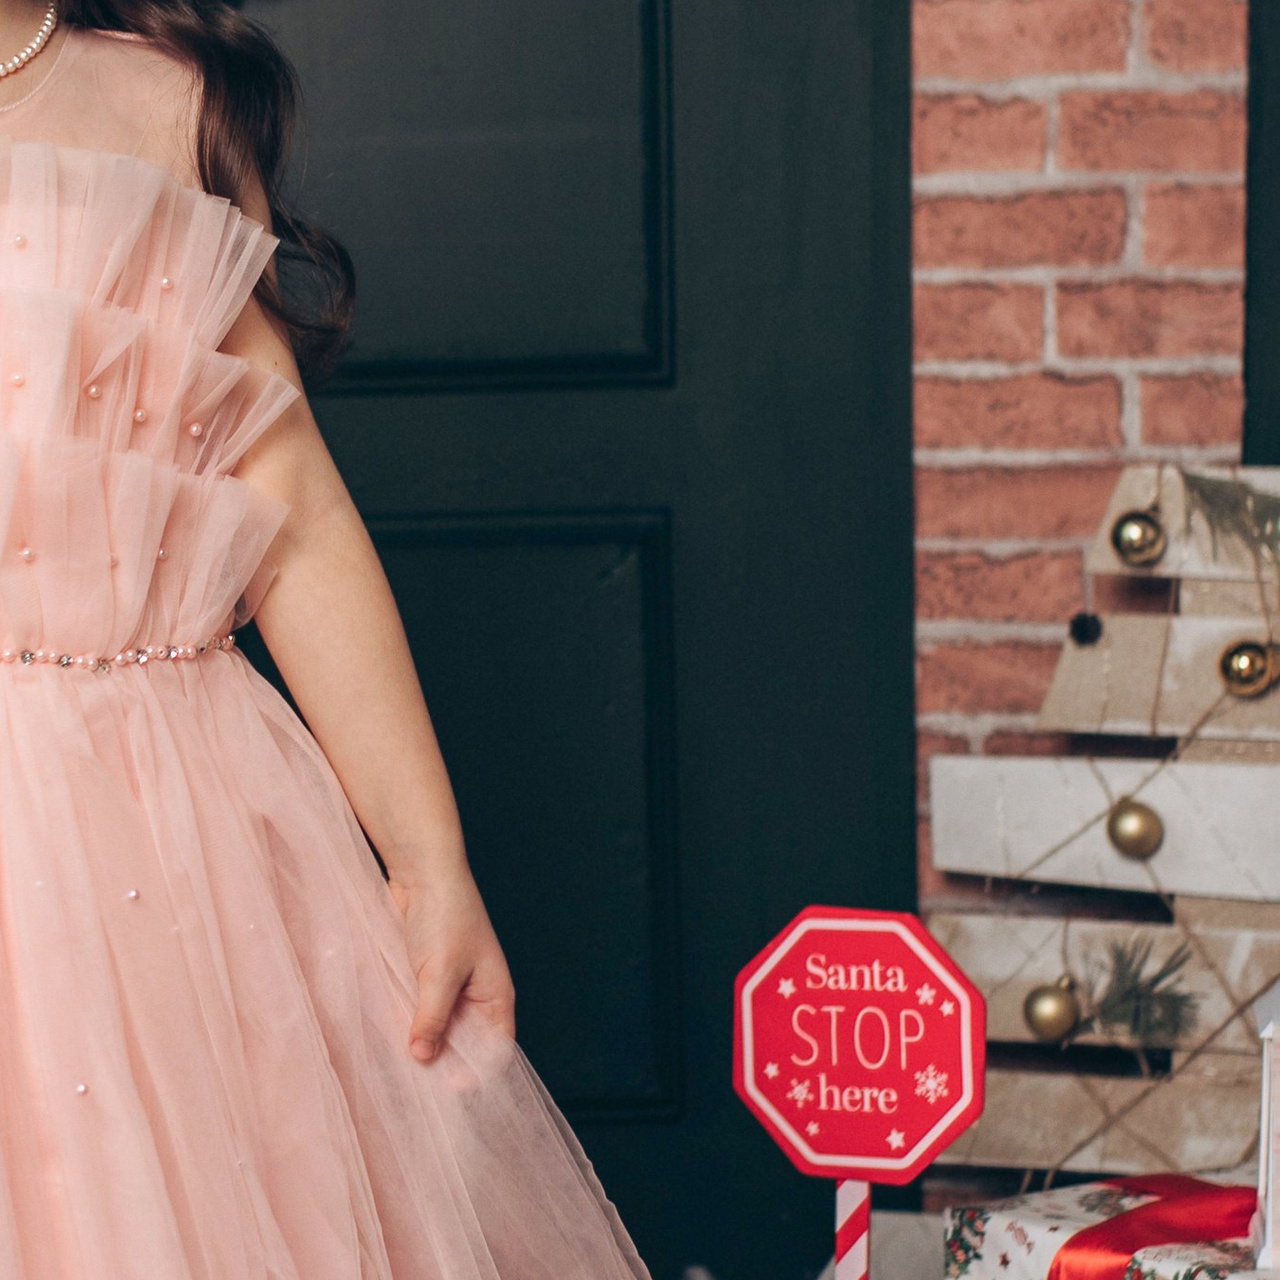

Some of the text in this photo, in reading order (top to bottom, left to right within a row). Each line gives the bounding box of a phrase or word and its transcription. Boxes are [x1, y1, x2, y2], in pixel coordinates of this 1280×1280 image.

[805, 953, 909, 993] Santa
[790, 1003, 925, 1071] STOP
[816, 1072, 899, 1114] here
